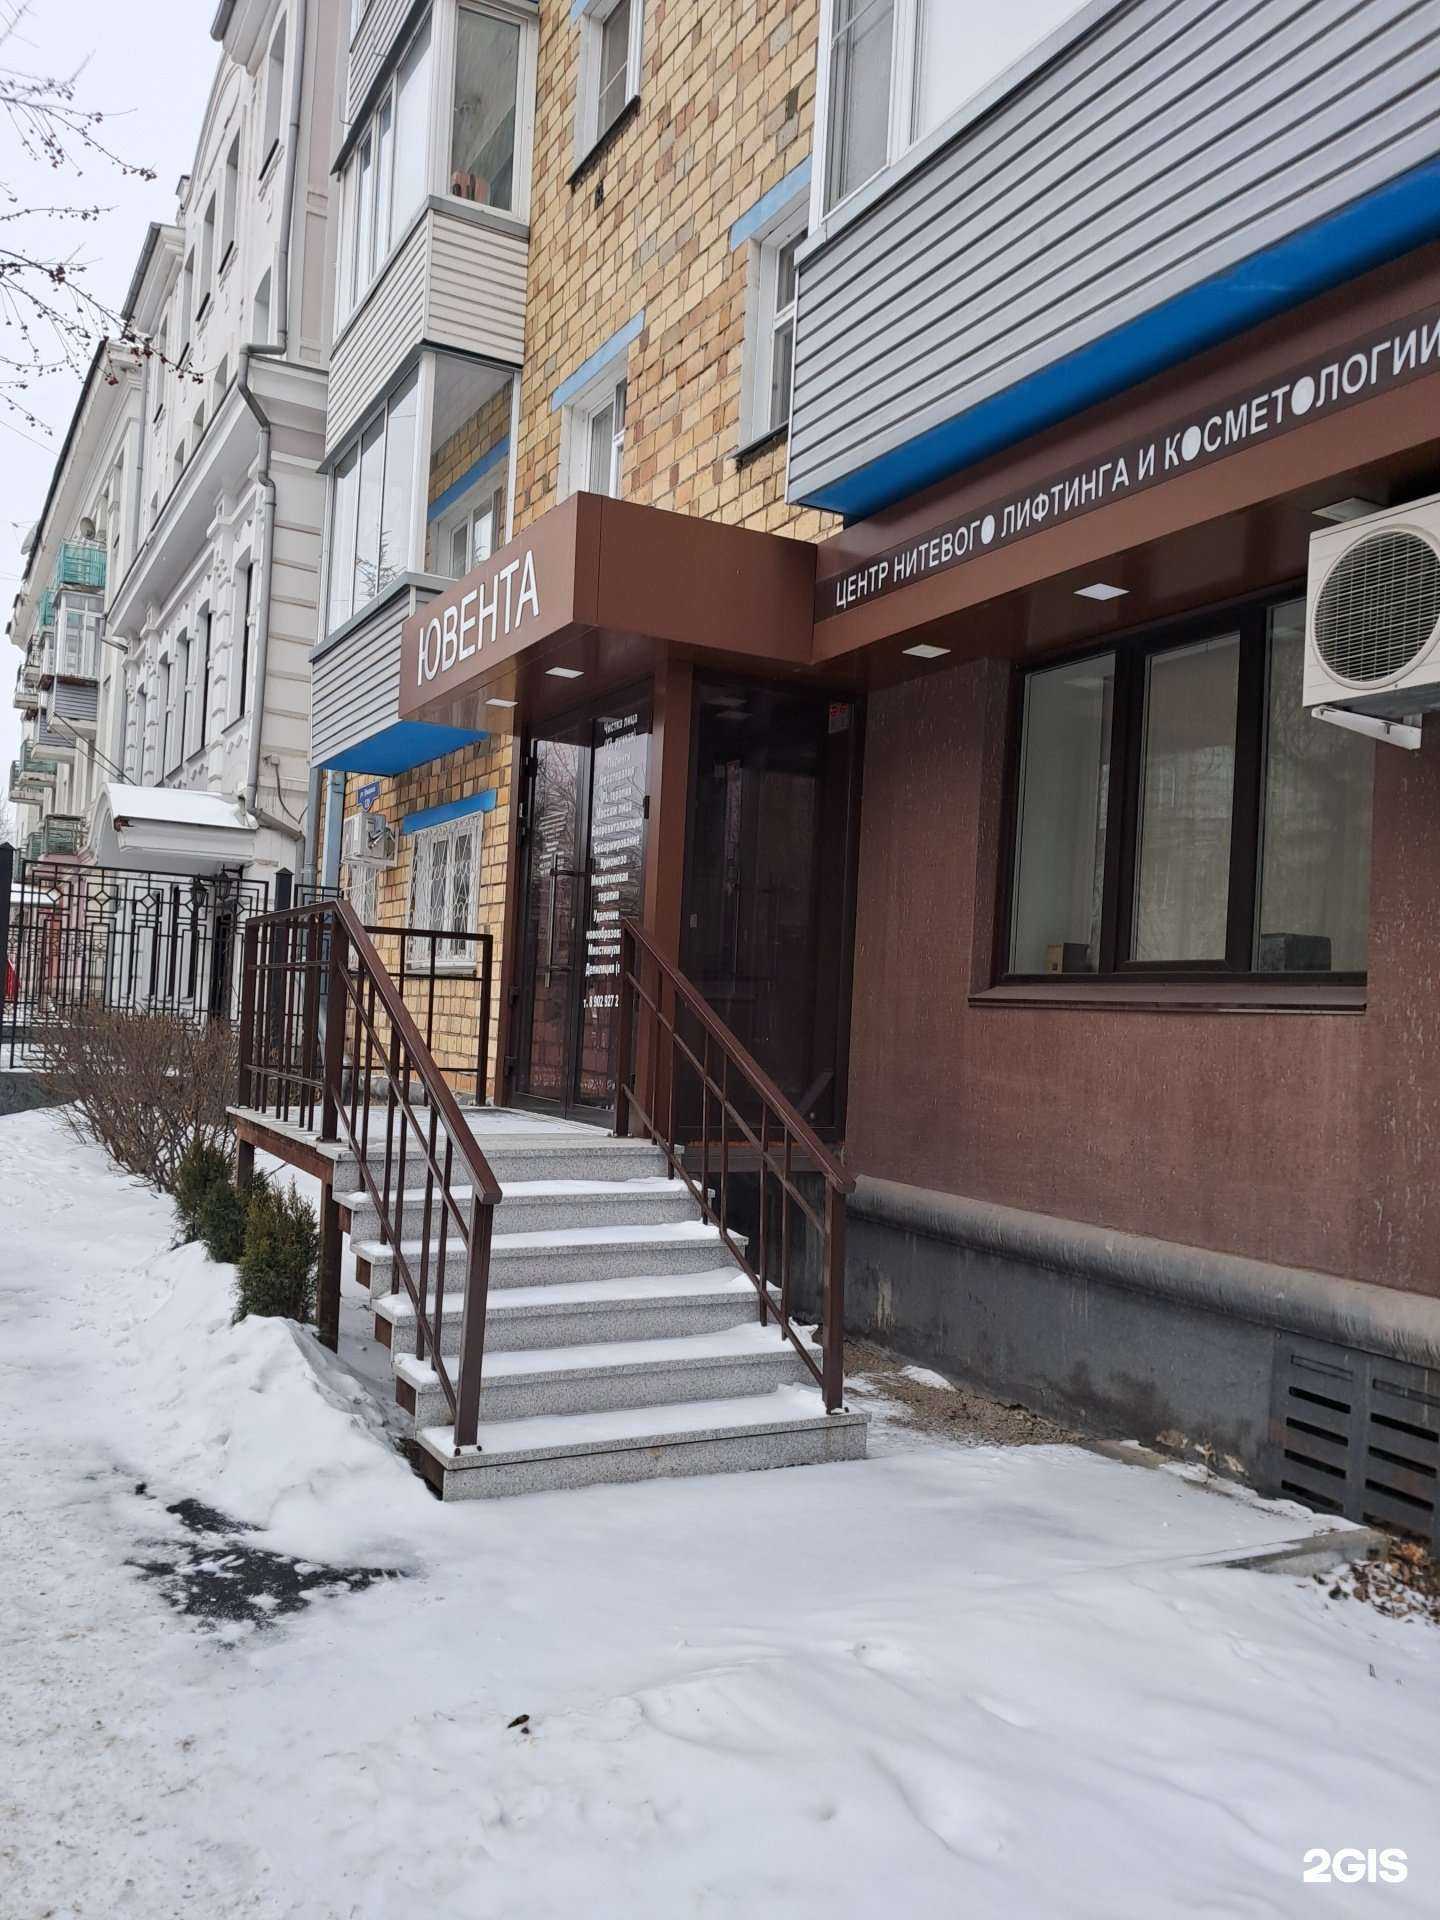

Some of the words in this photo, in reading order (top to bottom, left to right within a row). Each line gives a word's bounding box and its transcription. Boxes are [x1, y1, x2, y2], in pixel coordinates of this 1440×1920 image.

[836, 561, 888, 609] ЦЕНТР
[893, 514, 995, 584] НИТЕВОГО
[1000, 458, 1129, 538] ЛИФТИНГА
[1137, 444, 1156, 481] И
[1164, 317, 1440, 469] КОСМЕТОЛОГИИ
[416, 549, 540, 686] ЮВЕНТА
